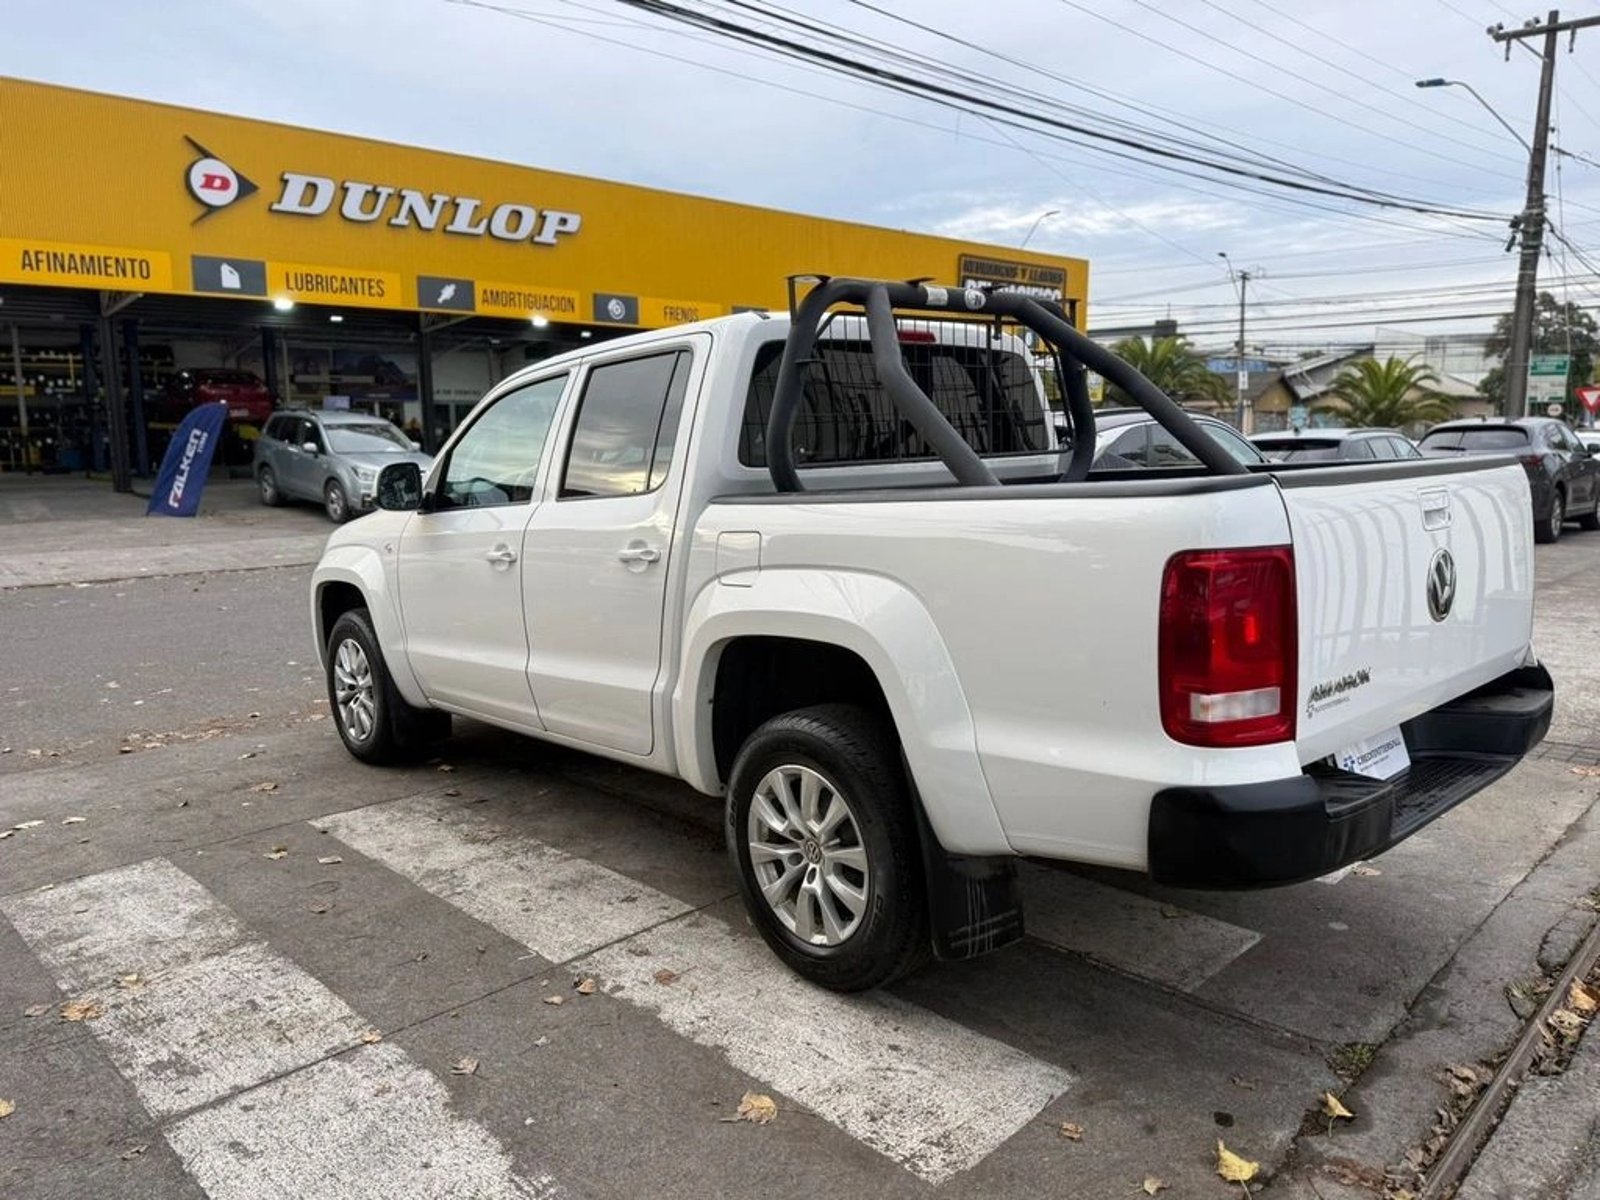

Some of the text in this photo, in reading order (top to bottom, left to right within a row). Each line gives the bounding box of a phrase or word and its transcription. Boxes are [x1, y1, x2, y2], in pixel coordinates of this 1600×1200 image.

[270, 172, 582, 245] DUNLOP
[20, 249, 151, 281] AFINAMIENTO
[285, 271, 385, 298] LUBRICANTES
[663, 304, 700, 323] FRENOS
